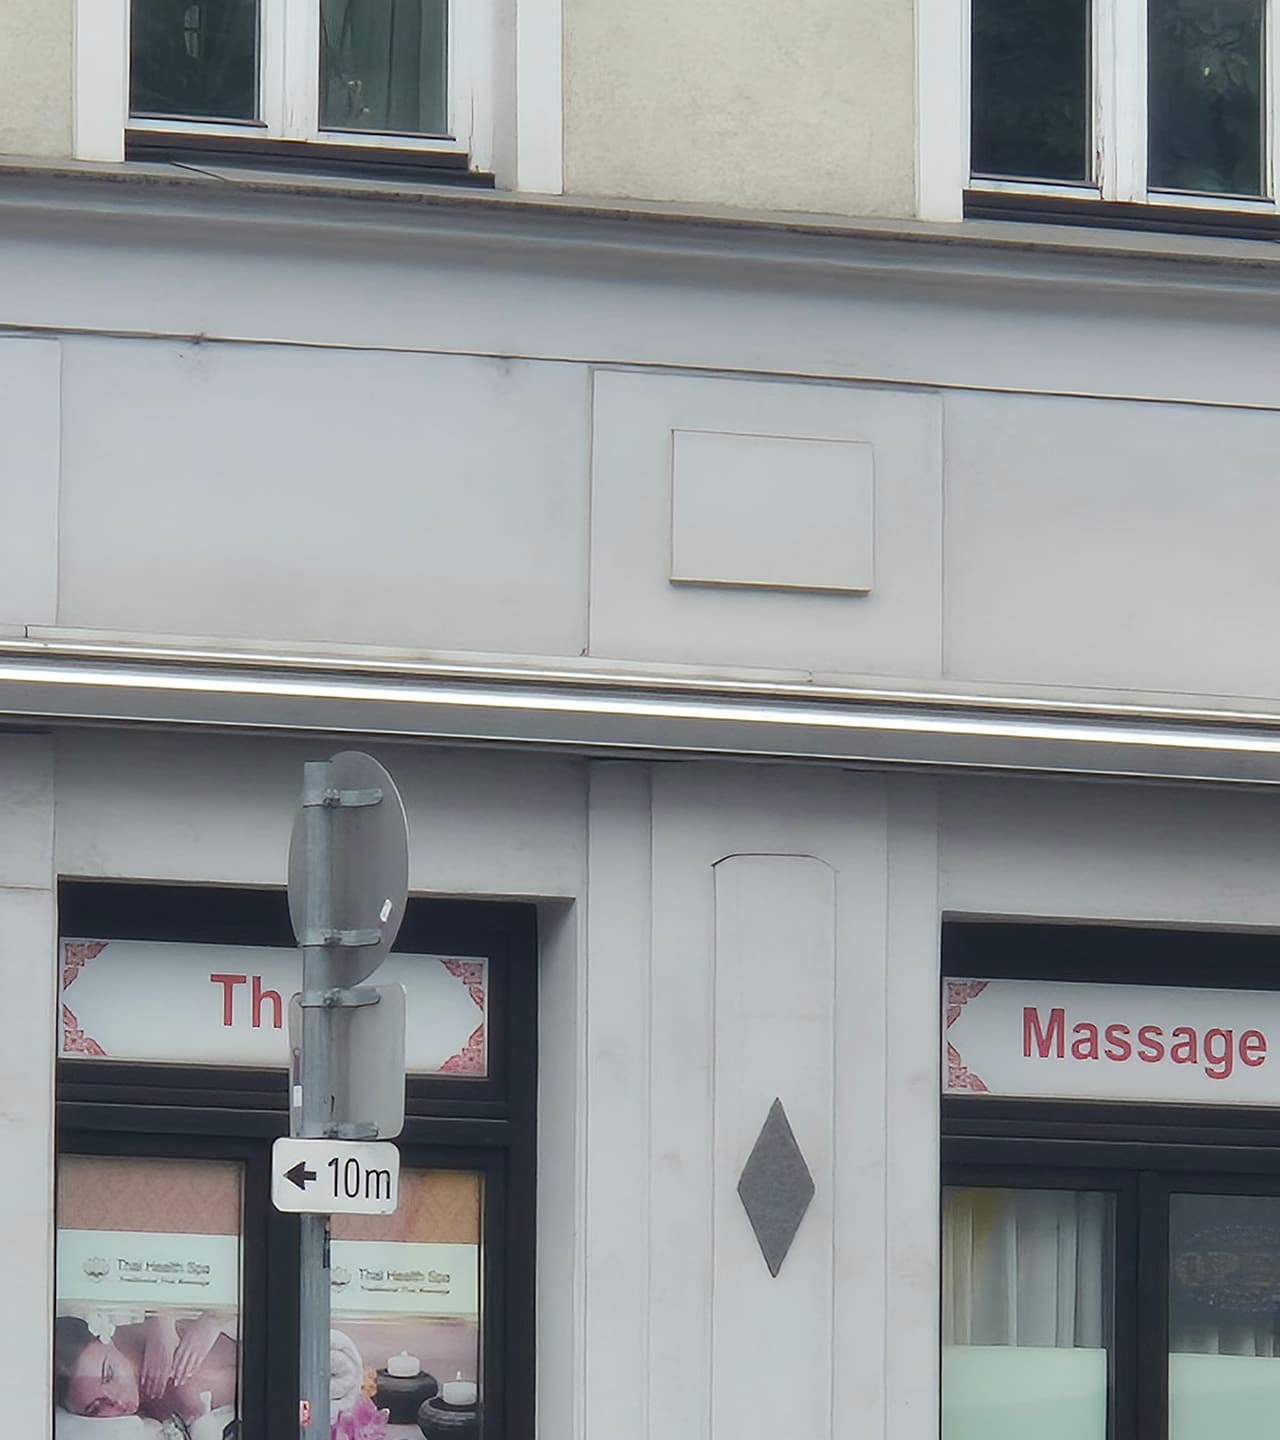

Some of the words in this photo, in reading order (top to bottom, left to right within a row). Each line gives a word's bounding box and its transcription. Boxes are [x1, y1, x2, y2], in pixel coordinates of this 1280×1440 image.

[210, 973, 282, 1028] Th
[1023, 1006, 1267, 1080] Massage
[327, 1157, 391, 1199] 10m
